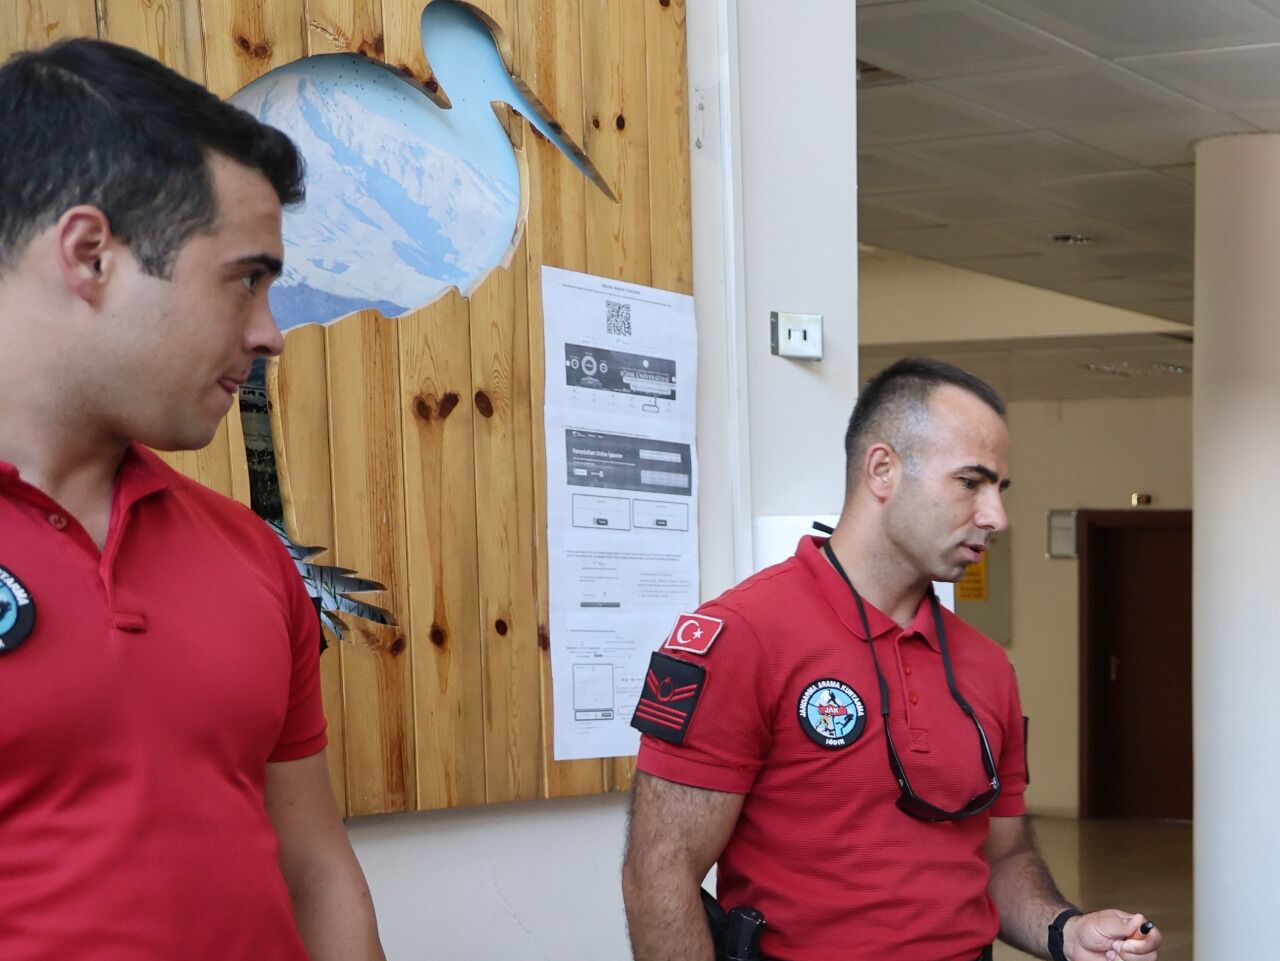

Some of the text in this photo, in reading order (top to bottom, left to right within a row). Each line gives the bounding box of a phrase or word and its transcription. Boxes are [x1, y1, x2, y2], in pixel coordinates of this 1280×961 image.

[799, 680, 865, 717] JANDARMA ARAMA KURTARMA
